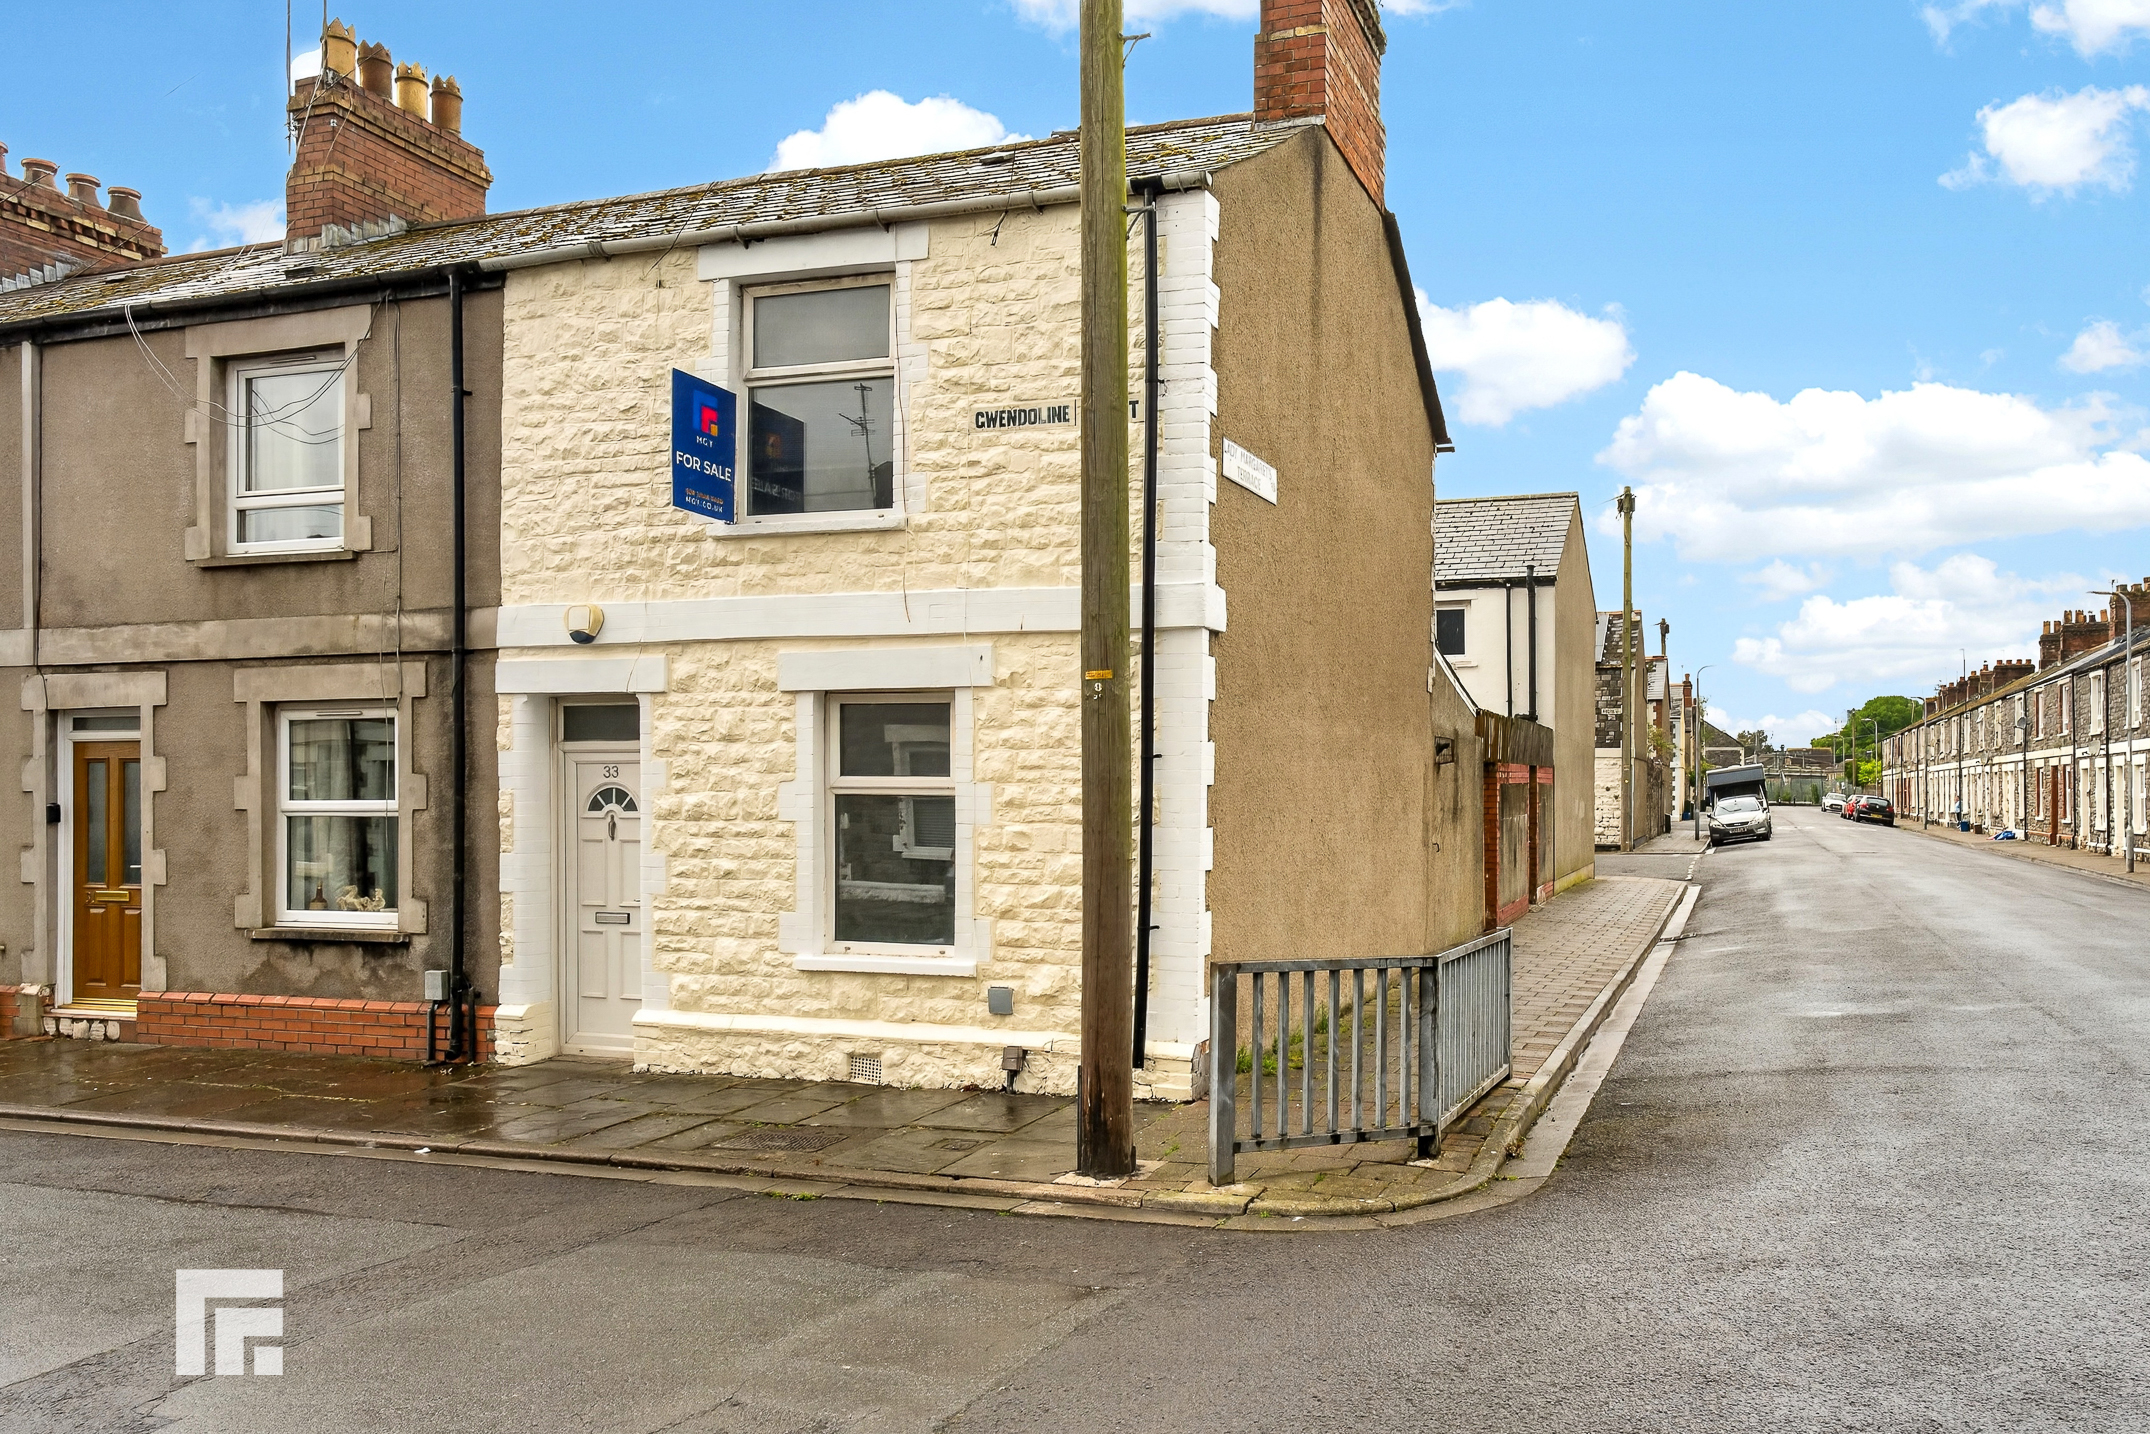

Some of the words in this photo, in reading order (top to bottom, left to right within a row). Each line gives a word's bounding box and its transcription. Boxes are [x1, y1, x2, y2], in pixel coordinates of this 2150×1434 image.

[975, 405, 1070, 429] GWENDOLINE
[676, 450, 701, 471] FOR
[703, 460, 732, 481] SALE
[603, 765, 619, 779] 33
